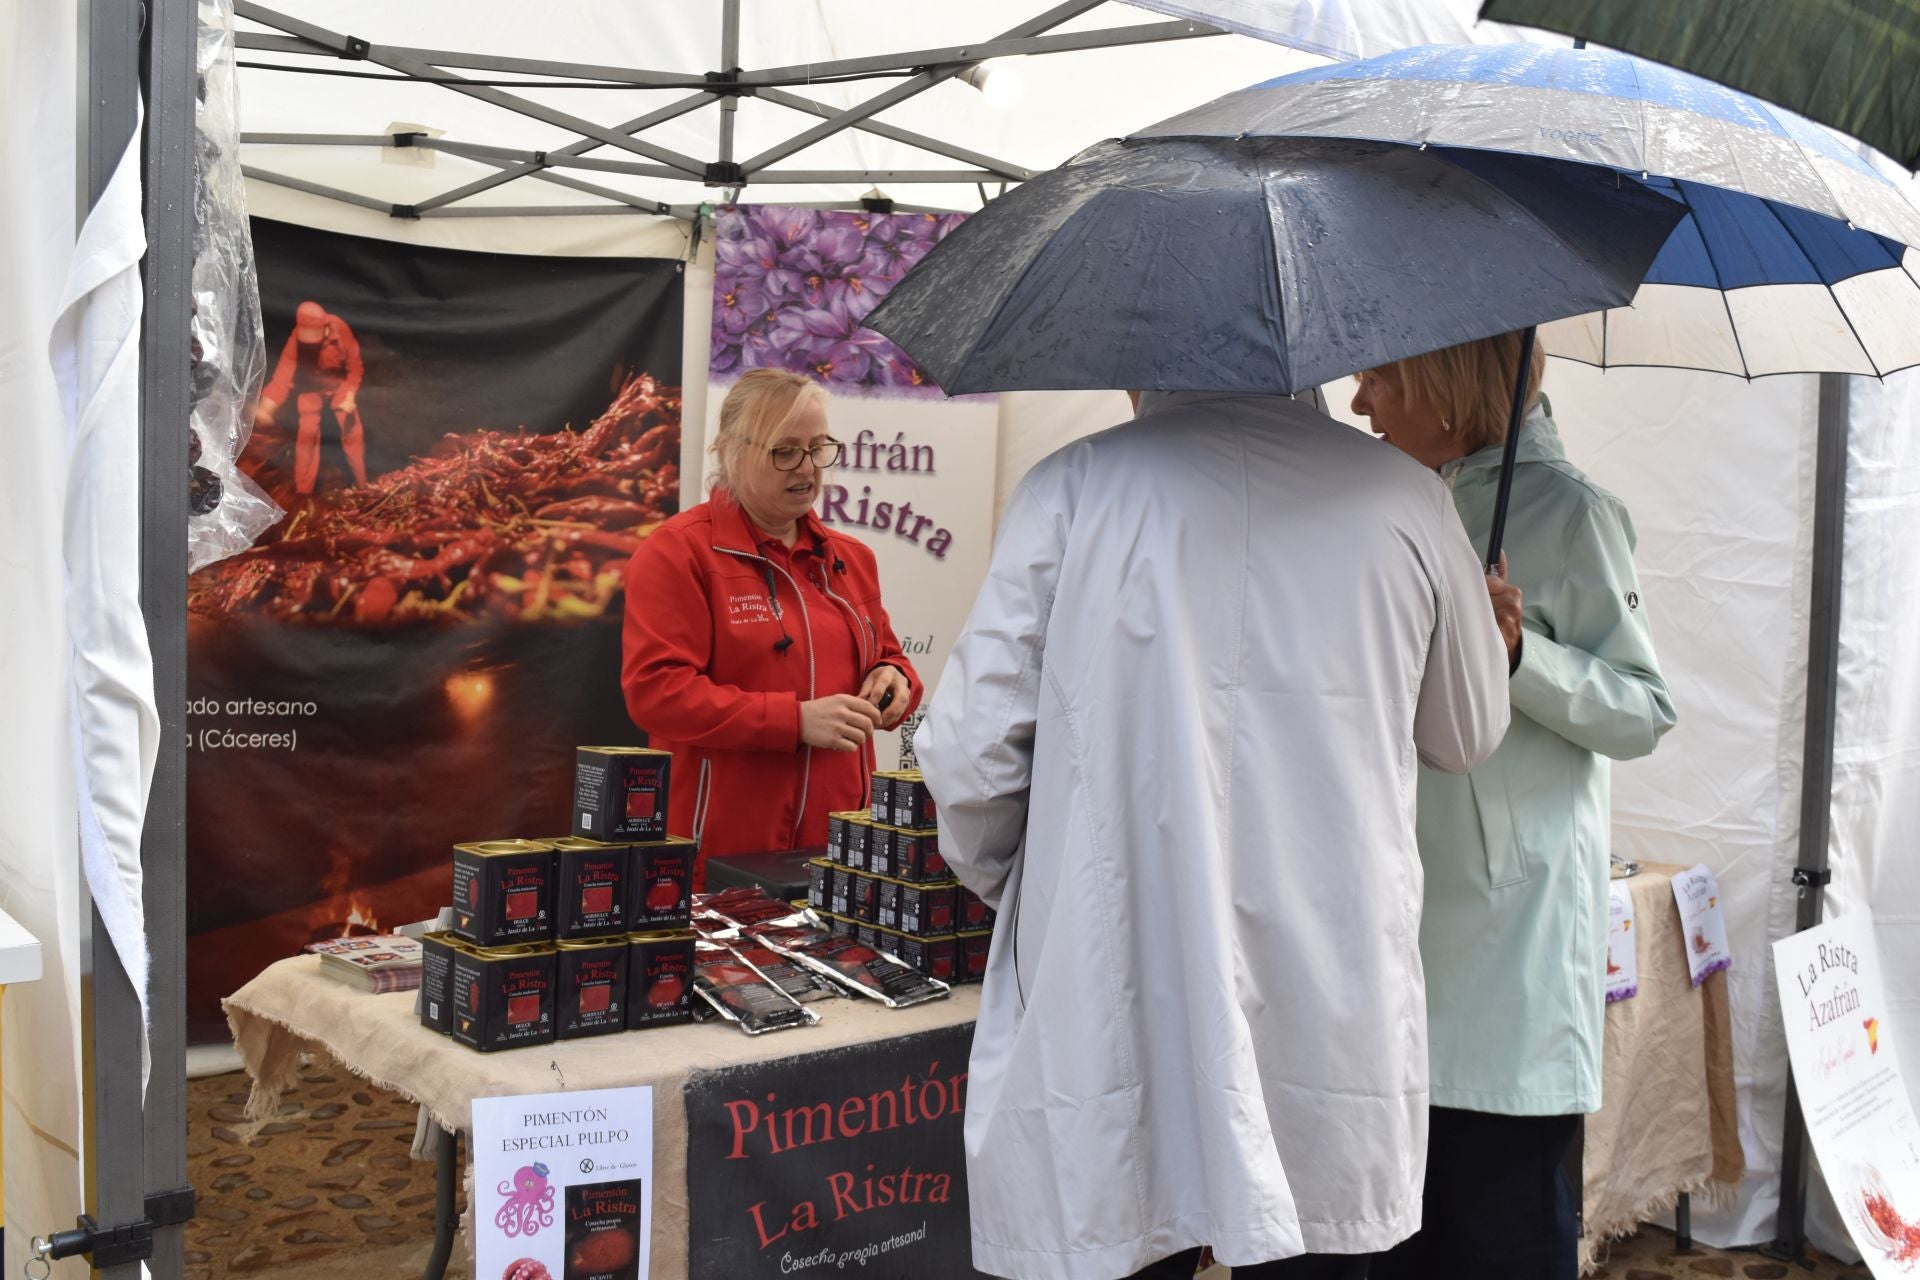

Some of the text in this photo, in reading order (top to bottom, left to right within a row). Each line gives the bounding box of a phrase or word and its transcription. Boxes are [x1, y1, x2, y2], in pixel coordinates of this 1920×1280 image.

[820, 484, 953, 557] Ristra
[729, 602, 767, 614] La Ristra
[225, 697, 318, 716] artesano
[200, 728, 297, 752] (Cáceres)
[1797, 939, 1859, 998] La Ristra
[1810, 981, 1861, 1032] Azafrán
[523, 1106, 608, 1127] PIMENTÓN
[502, 1129, 630, 1152] ESPECIAL PULPO
[582, 1186, 628, 1200] Pimentón
[571, 1199, 637, 1221] La Ristra
[747, 1164, 952, 1250] La Ristra
[780, 1221, 927, 1274] Cosecha propia artesanal
